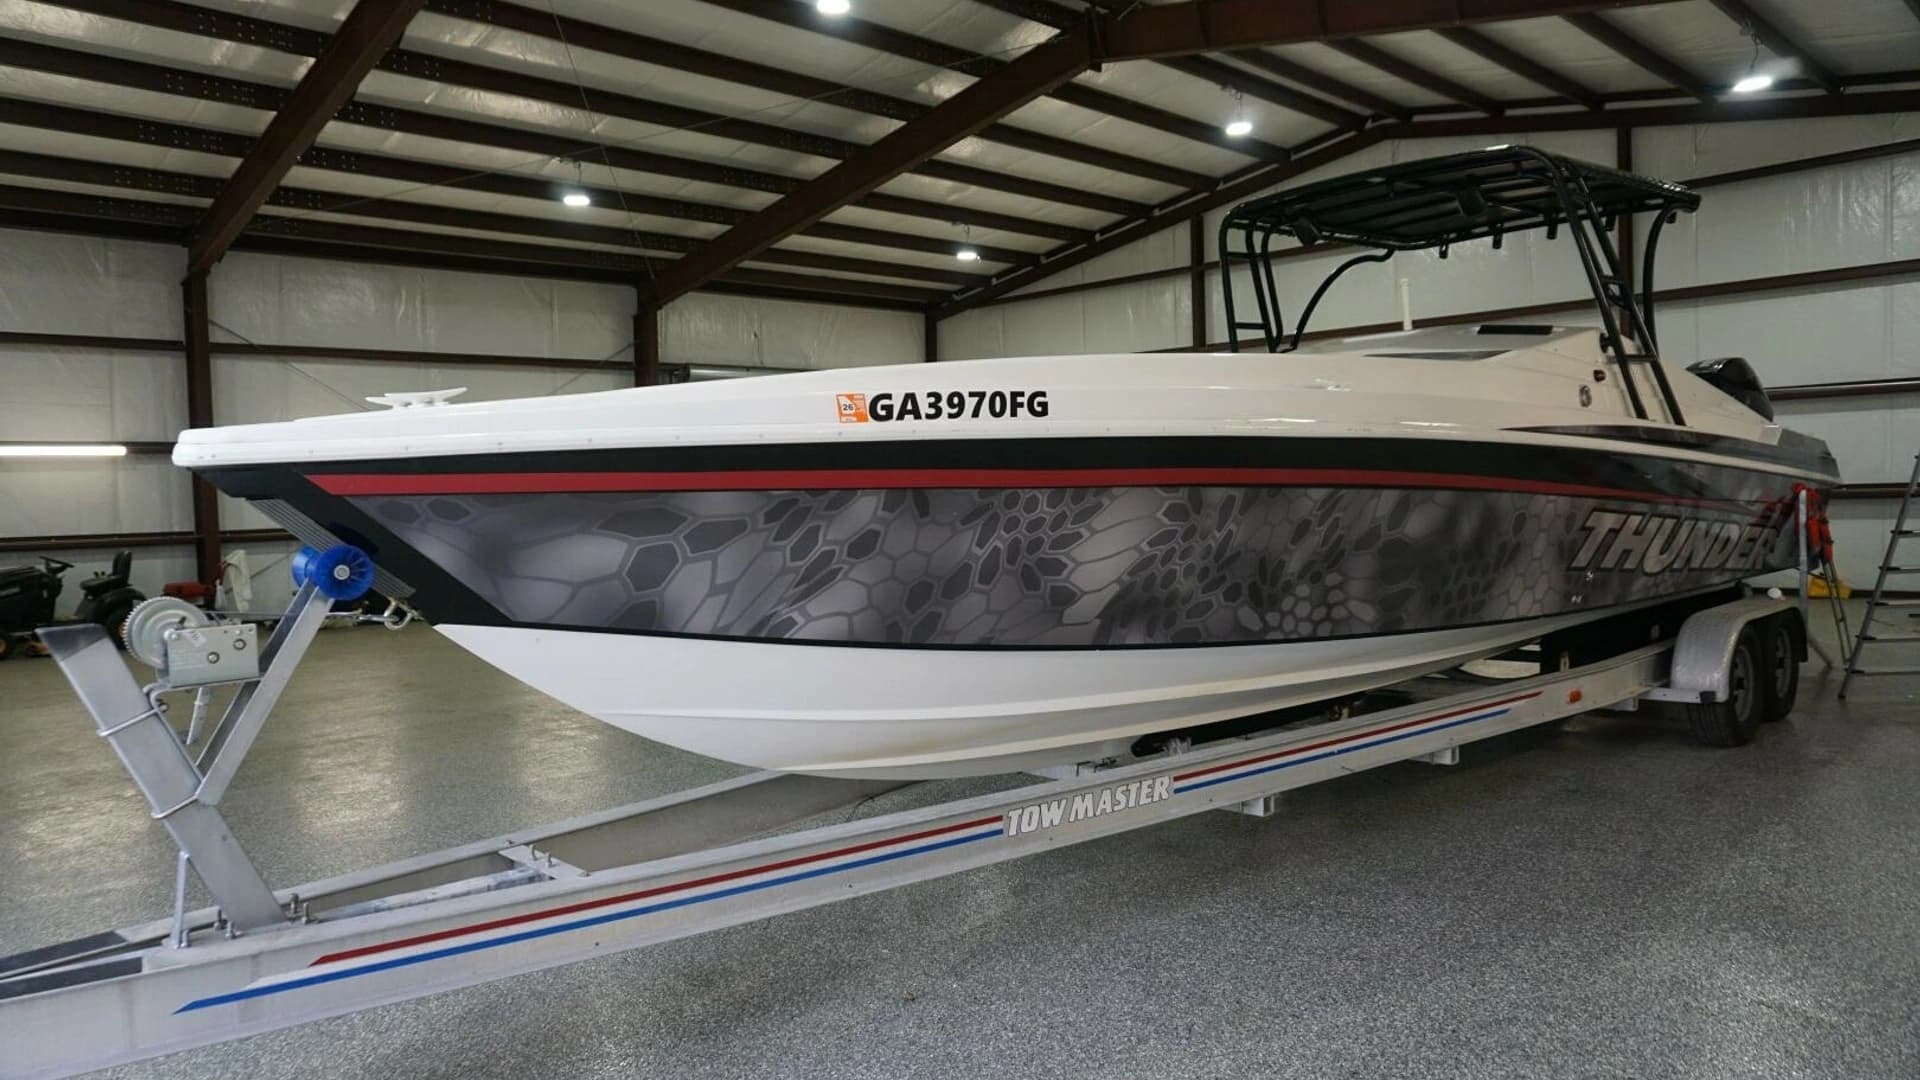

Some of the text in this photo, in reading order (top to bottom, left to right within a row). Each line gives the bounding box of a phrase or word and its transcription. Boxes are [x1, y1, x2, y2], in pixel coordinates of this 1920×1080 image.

[842, 403, 854, 411] 26
[868, 390, 1049, 422] GA3970FG
[1569, 509, 1779, 575] THUNDER
[1007, 776, 1171, 836] TOW MASTER
